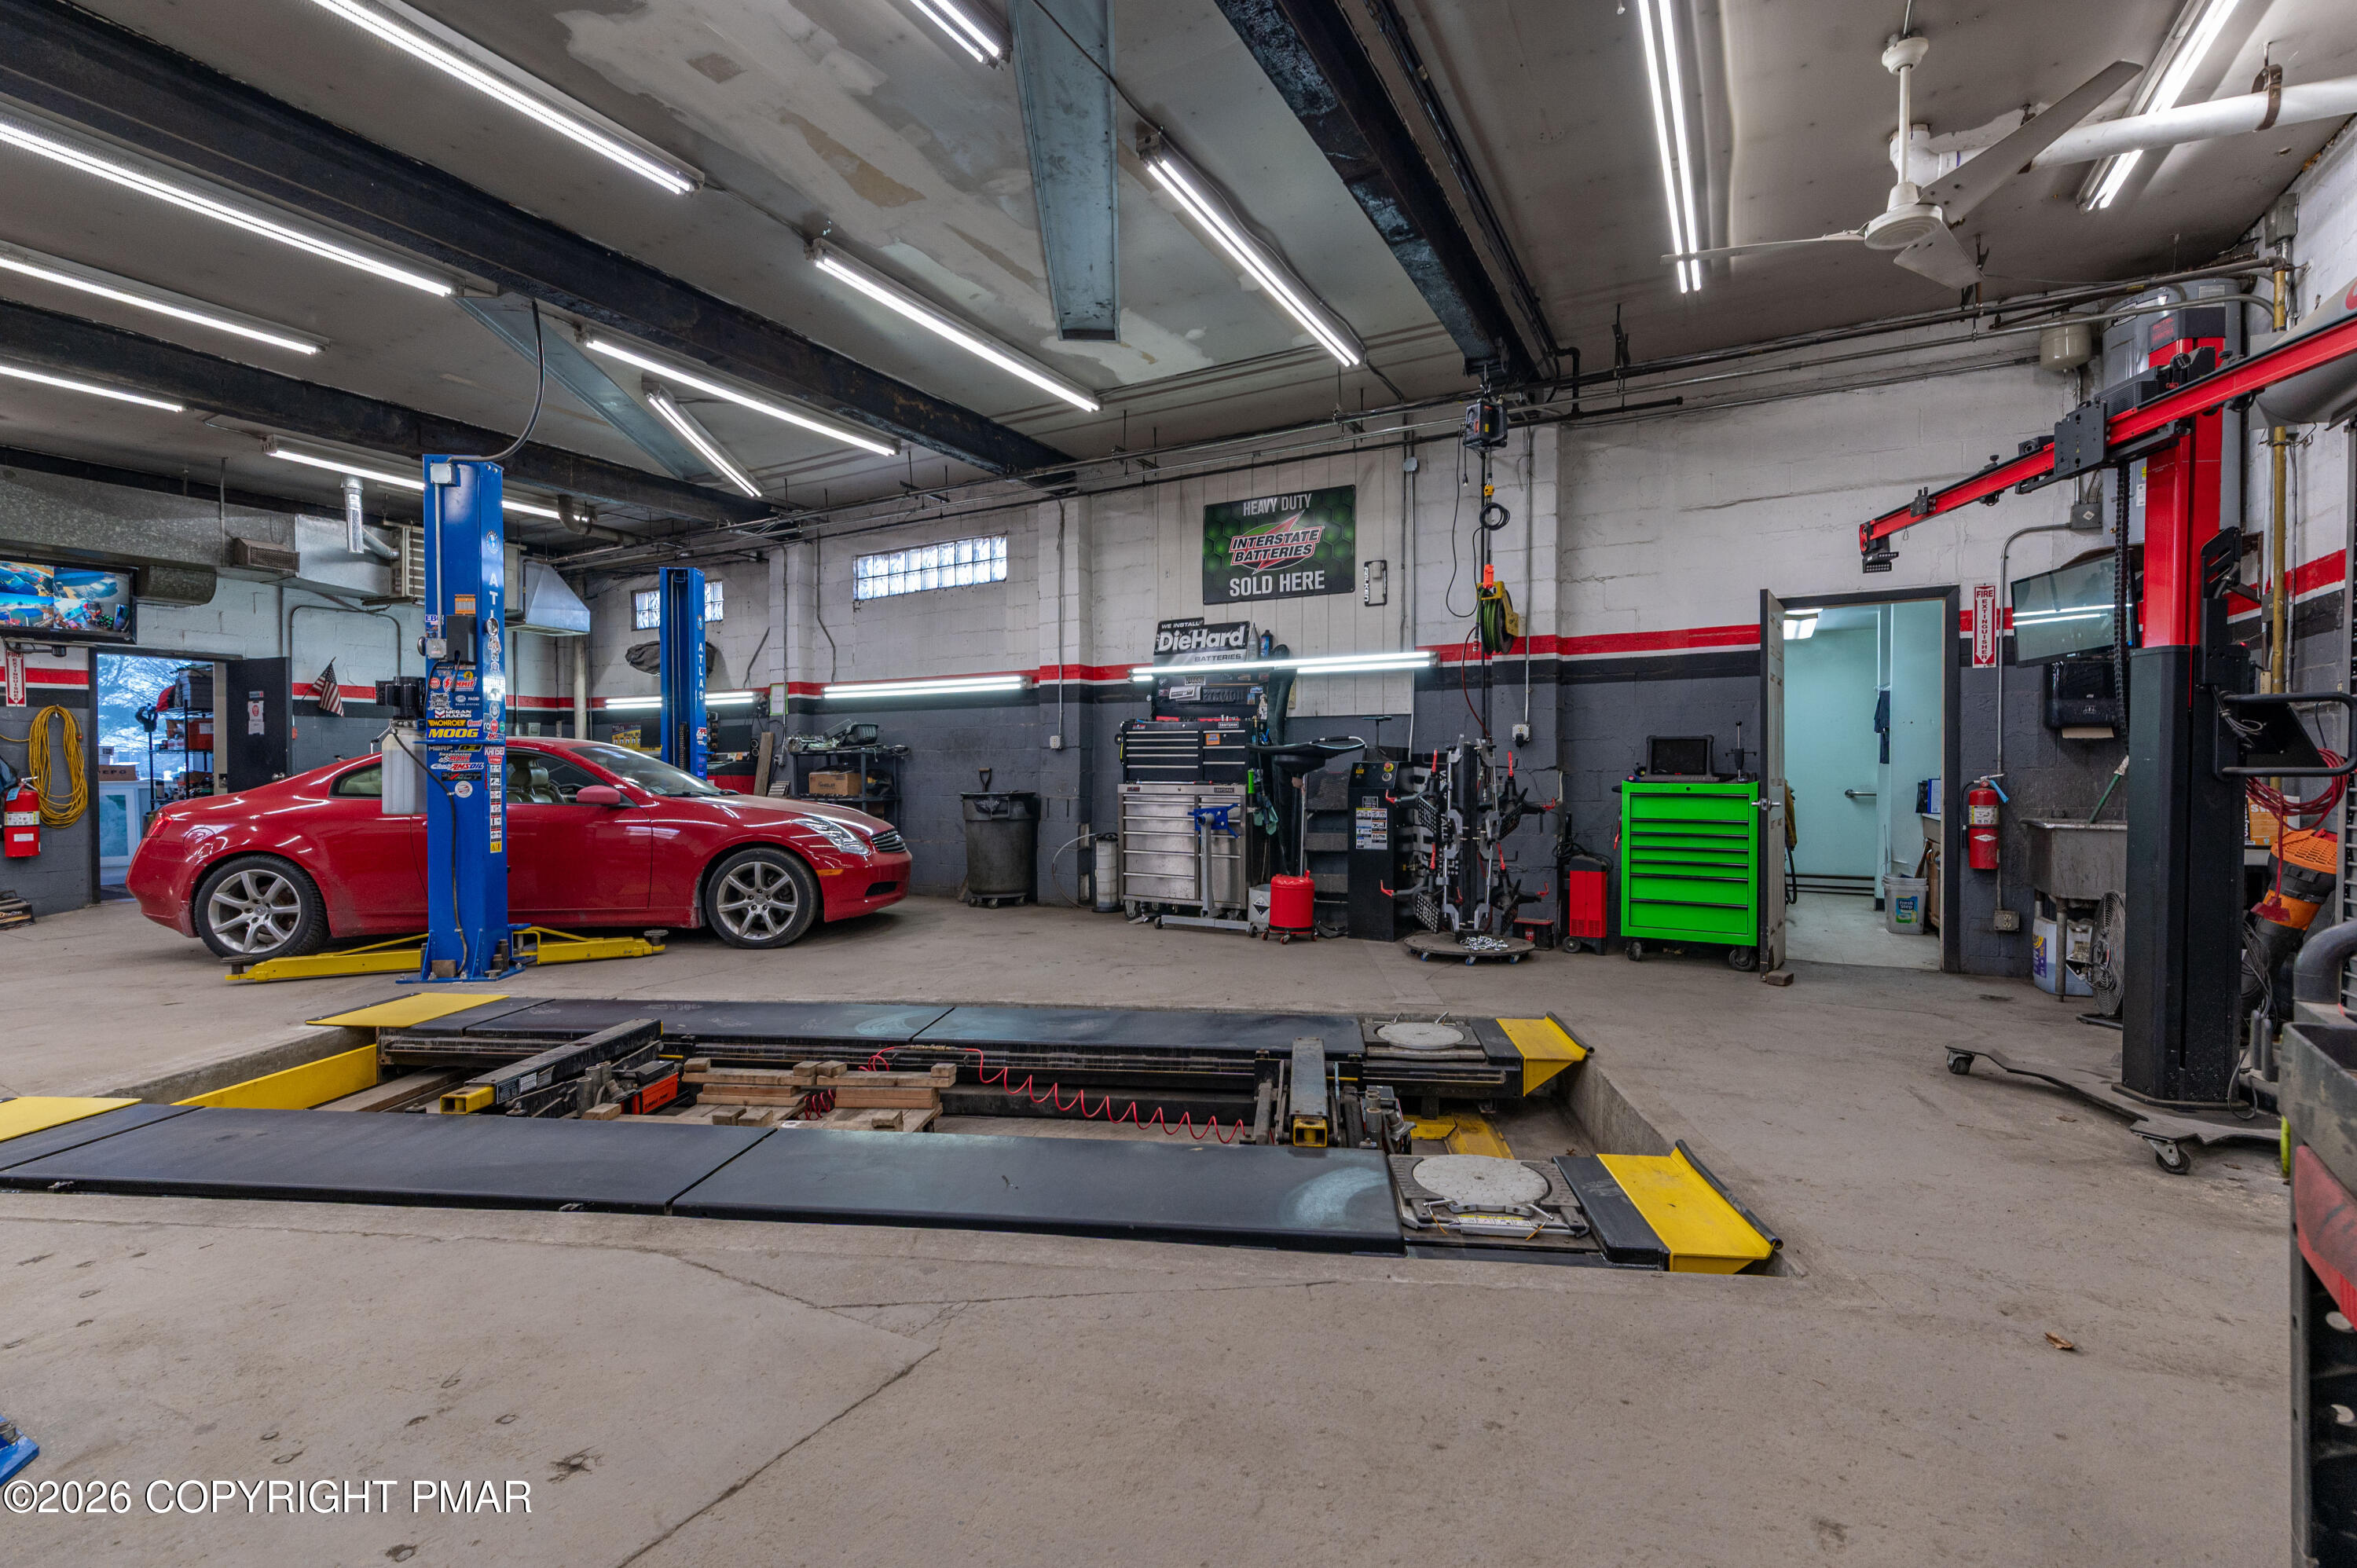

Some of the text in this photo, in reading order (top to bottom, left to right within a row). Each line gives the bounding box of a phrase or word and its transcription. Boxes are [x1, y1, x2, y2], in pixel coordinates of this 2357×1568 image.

[1244, 493, 1311, 516] HEAVY DUTY
[1233, 529, 1320, 550] INTERSTATE
[1235, 544, 1314, 562] BATTERIES
[1230, 570, 1325, 597] SOLD HERE
[1157, 625, 1245, 651] DieHard
[1195, 654, 1241, 662] BATTERIES
[428, 728, 479, 738] MOOG
